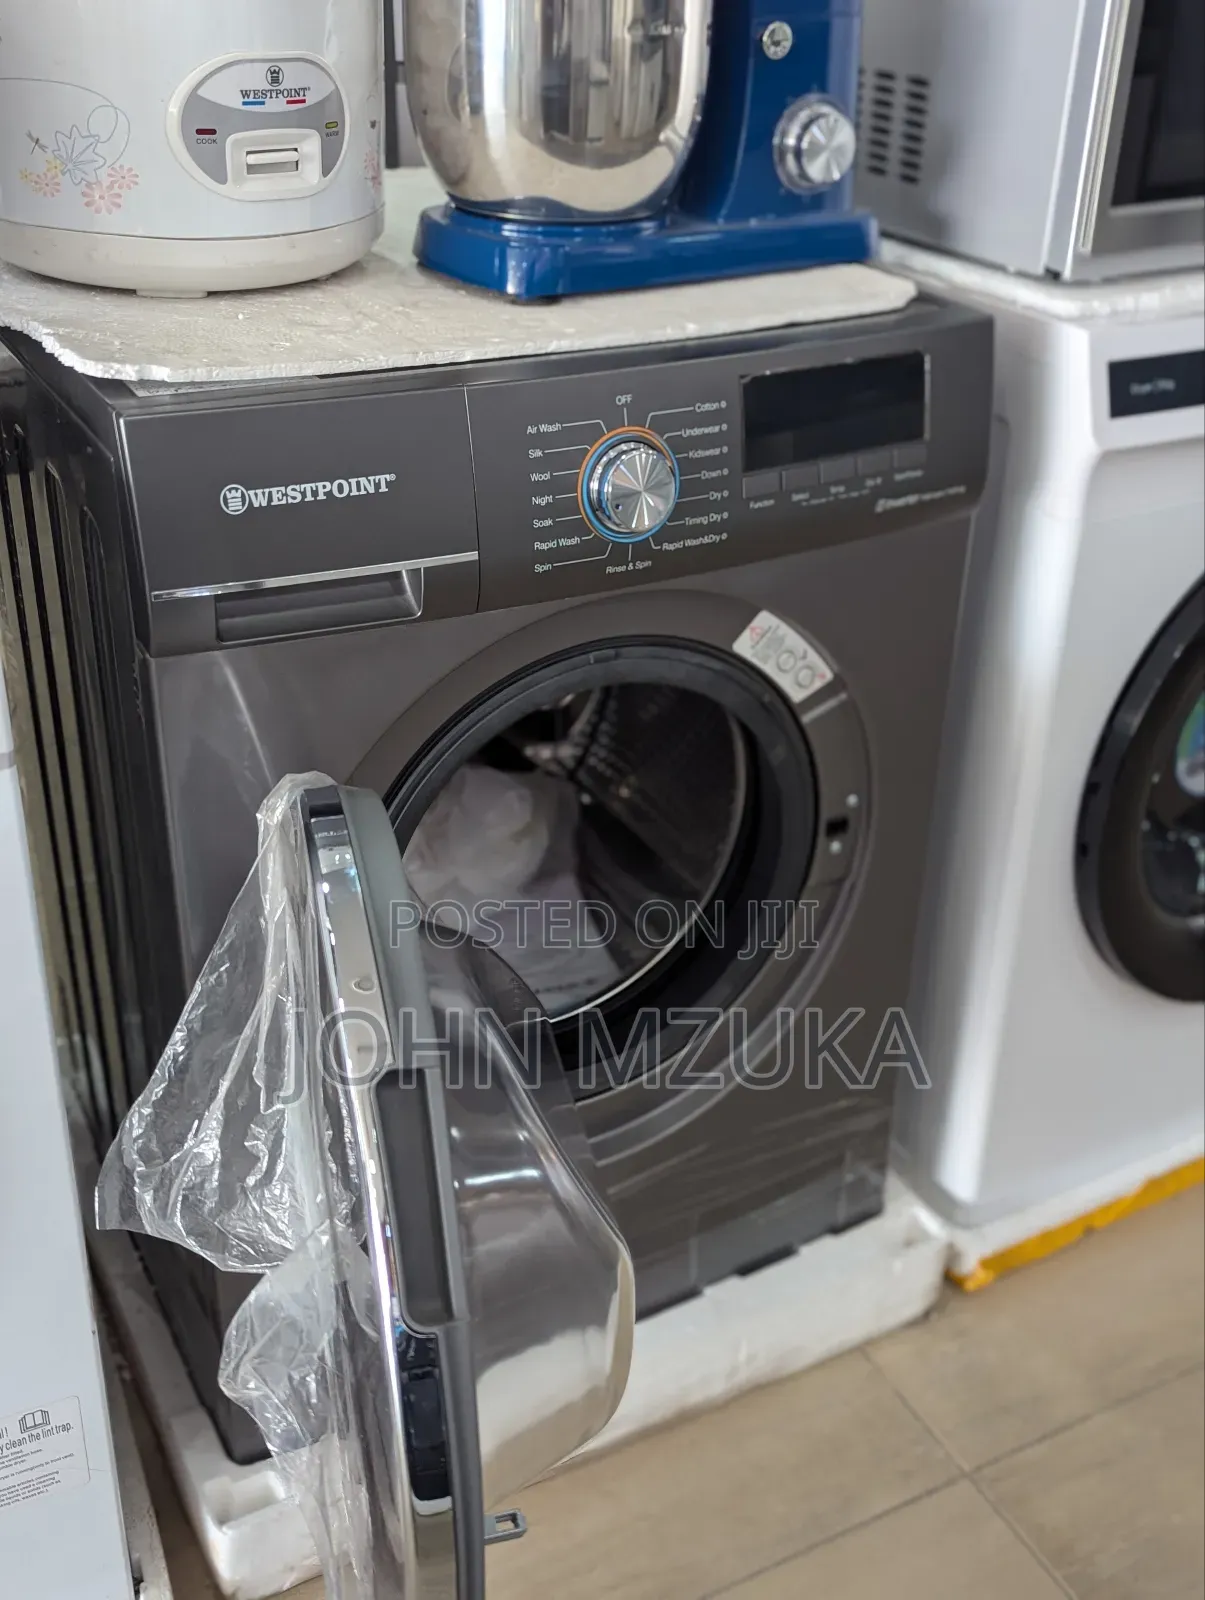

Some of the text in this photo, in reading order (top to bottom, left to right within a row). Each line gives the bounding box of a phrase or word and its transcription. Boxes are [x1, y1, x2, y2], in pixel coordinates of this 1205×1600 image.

[616, 394, 632, 405] OFF
[695, 402, 720, 412] Cotton
[526, 422, 562, 435] Air Wash
[681, 425, 720, 437] Underwear
[528, 449, 544, 459] Silk
[530, 471, 551, 482] Wool
[701, 469, 722, 480] Down
[532, 495, 553, 506] Night
[709, 491, 722, 500] Dry
[533, 517, 554, 528] Soak
[685, 513, 722, 526] Timing Dry
[534, 536, 580, 551] Rapid Wash
[662, 541, 683, 552] Rapid
[534, 562, 552, 573] Spin
[605, 560, 652, 574] Rinse & Spin
[5, 1436, 28, 1451] clean
[28, 1432, 41, 1444] the
[42, 1426, 55, 1439] lint
[55, 1421, 74, 1435] trap.
